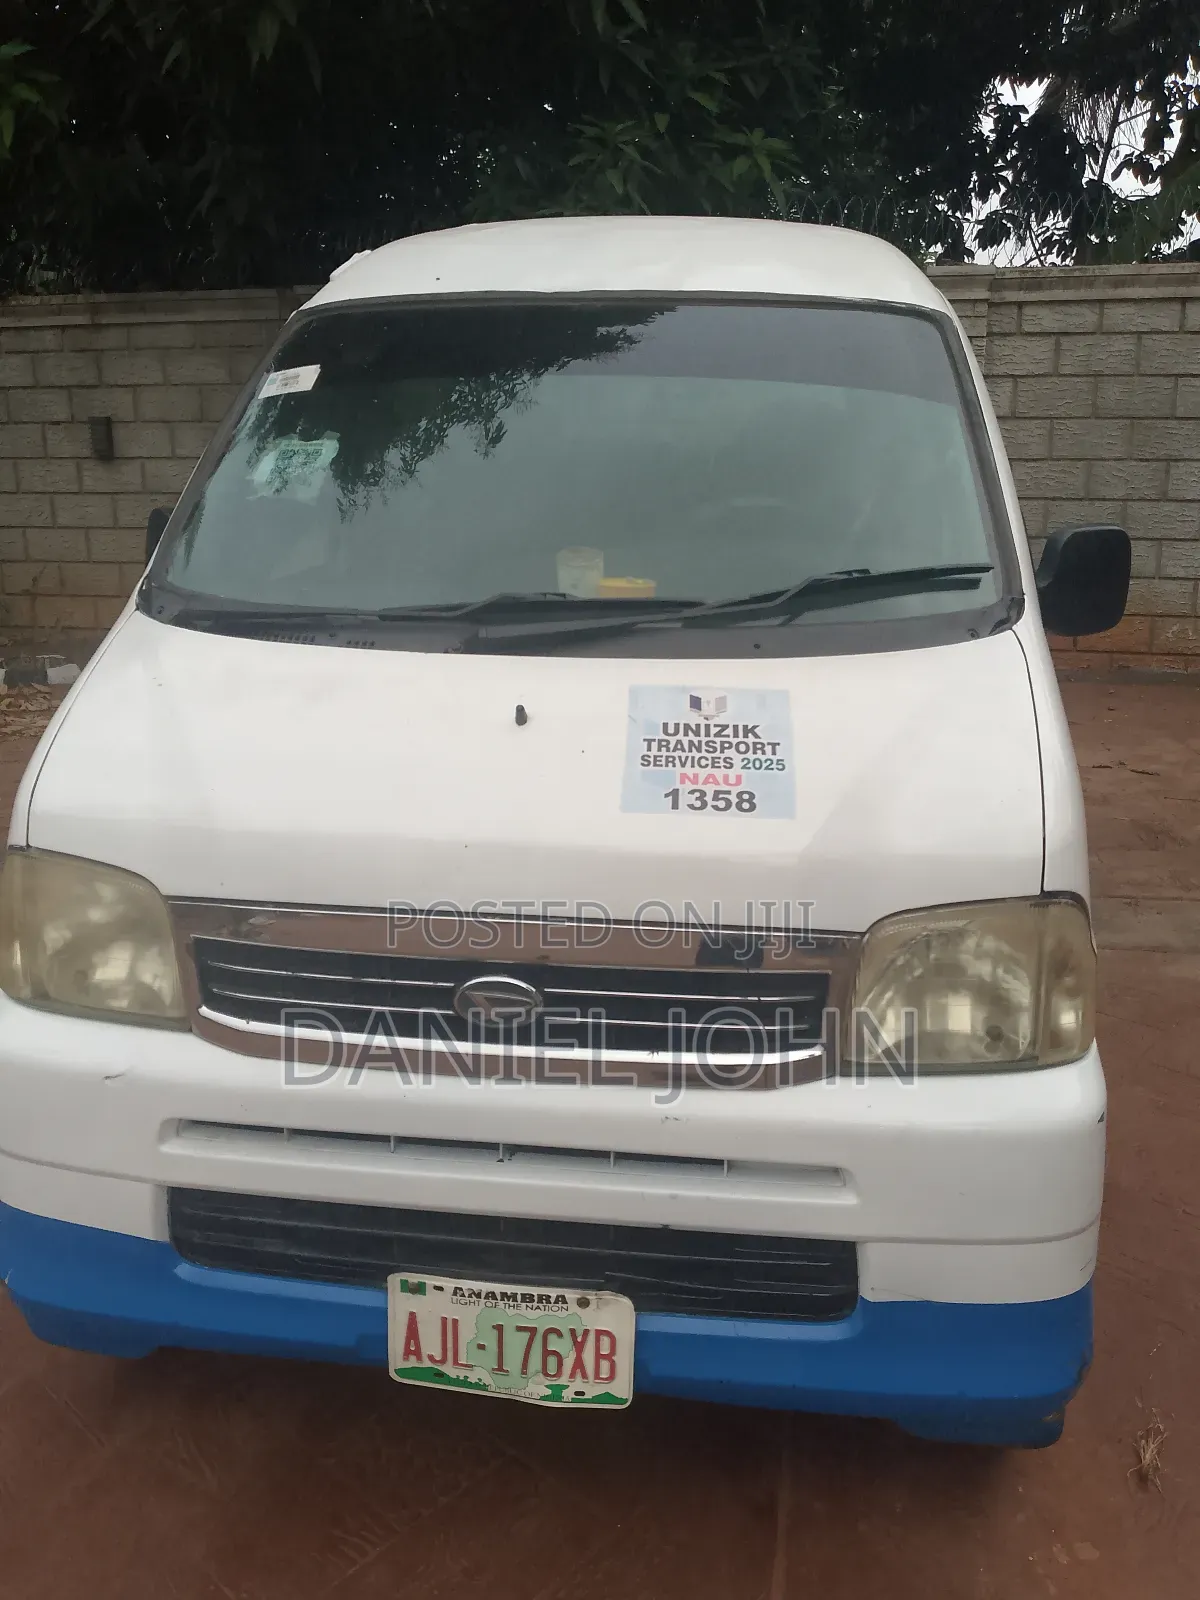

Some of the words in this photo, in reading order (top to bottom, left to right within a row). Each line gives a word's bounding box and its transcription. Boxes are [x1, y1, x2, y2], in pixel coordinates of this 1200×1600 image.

[662, 722, 762, 739] UNIZIK
[643, 738, 781, 756] TRANSPORT
[640, 754, 734, 770] SERVICES
[740, 757, 786, 771] 2025
[679, 773, 743, 787] NAU
[664, 788, 757, 813] 1358
[452, 1286, 569, 1305] ANAMBRA
[451, 1297, 482, 1307] LIGHT
[484, 1300, 501, 1308] OF
[502, 1302, 522, 1311] THE
[525, 1304, 569, 1313] NATION
[403, 1311, 617, 1383] AJL-176XB
